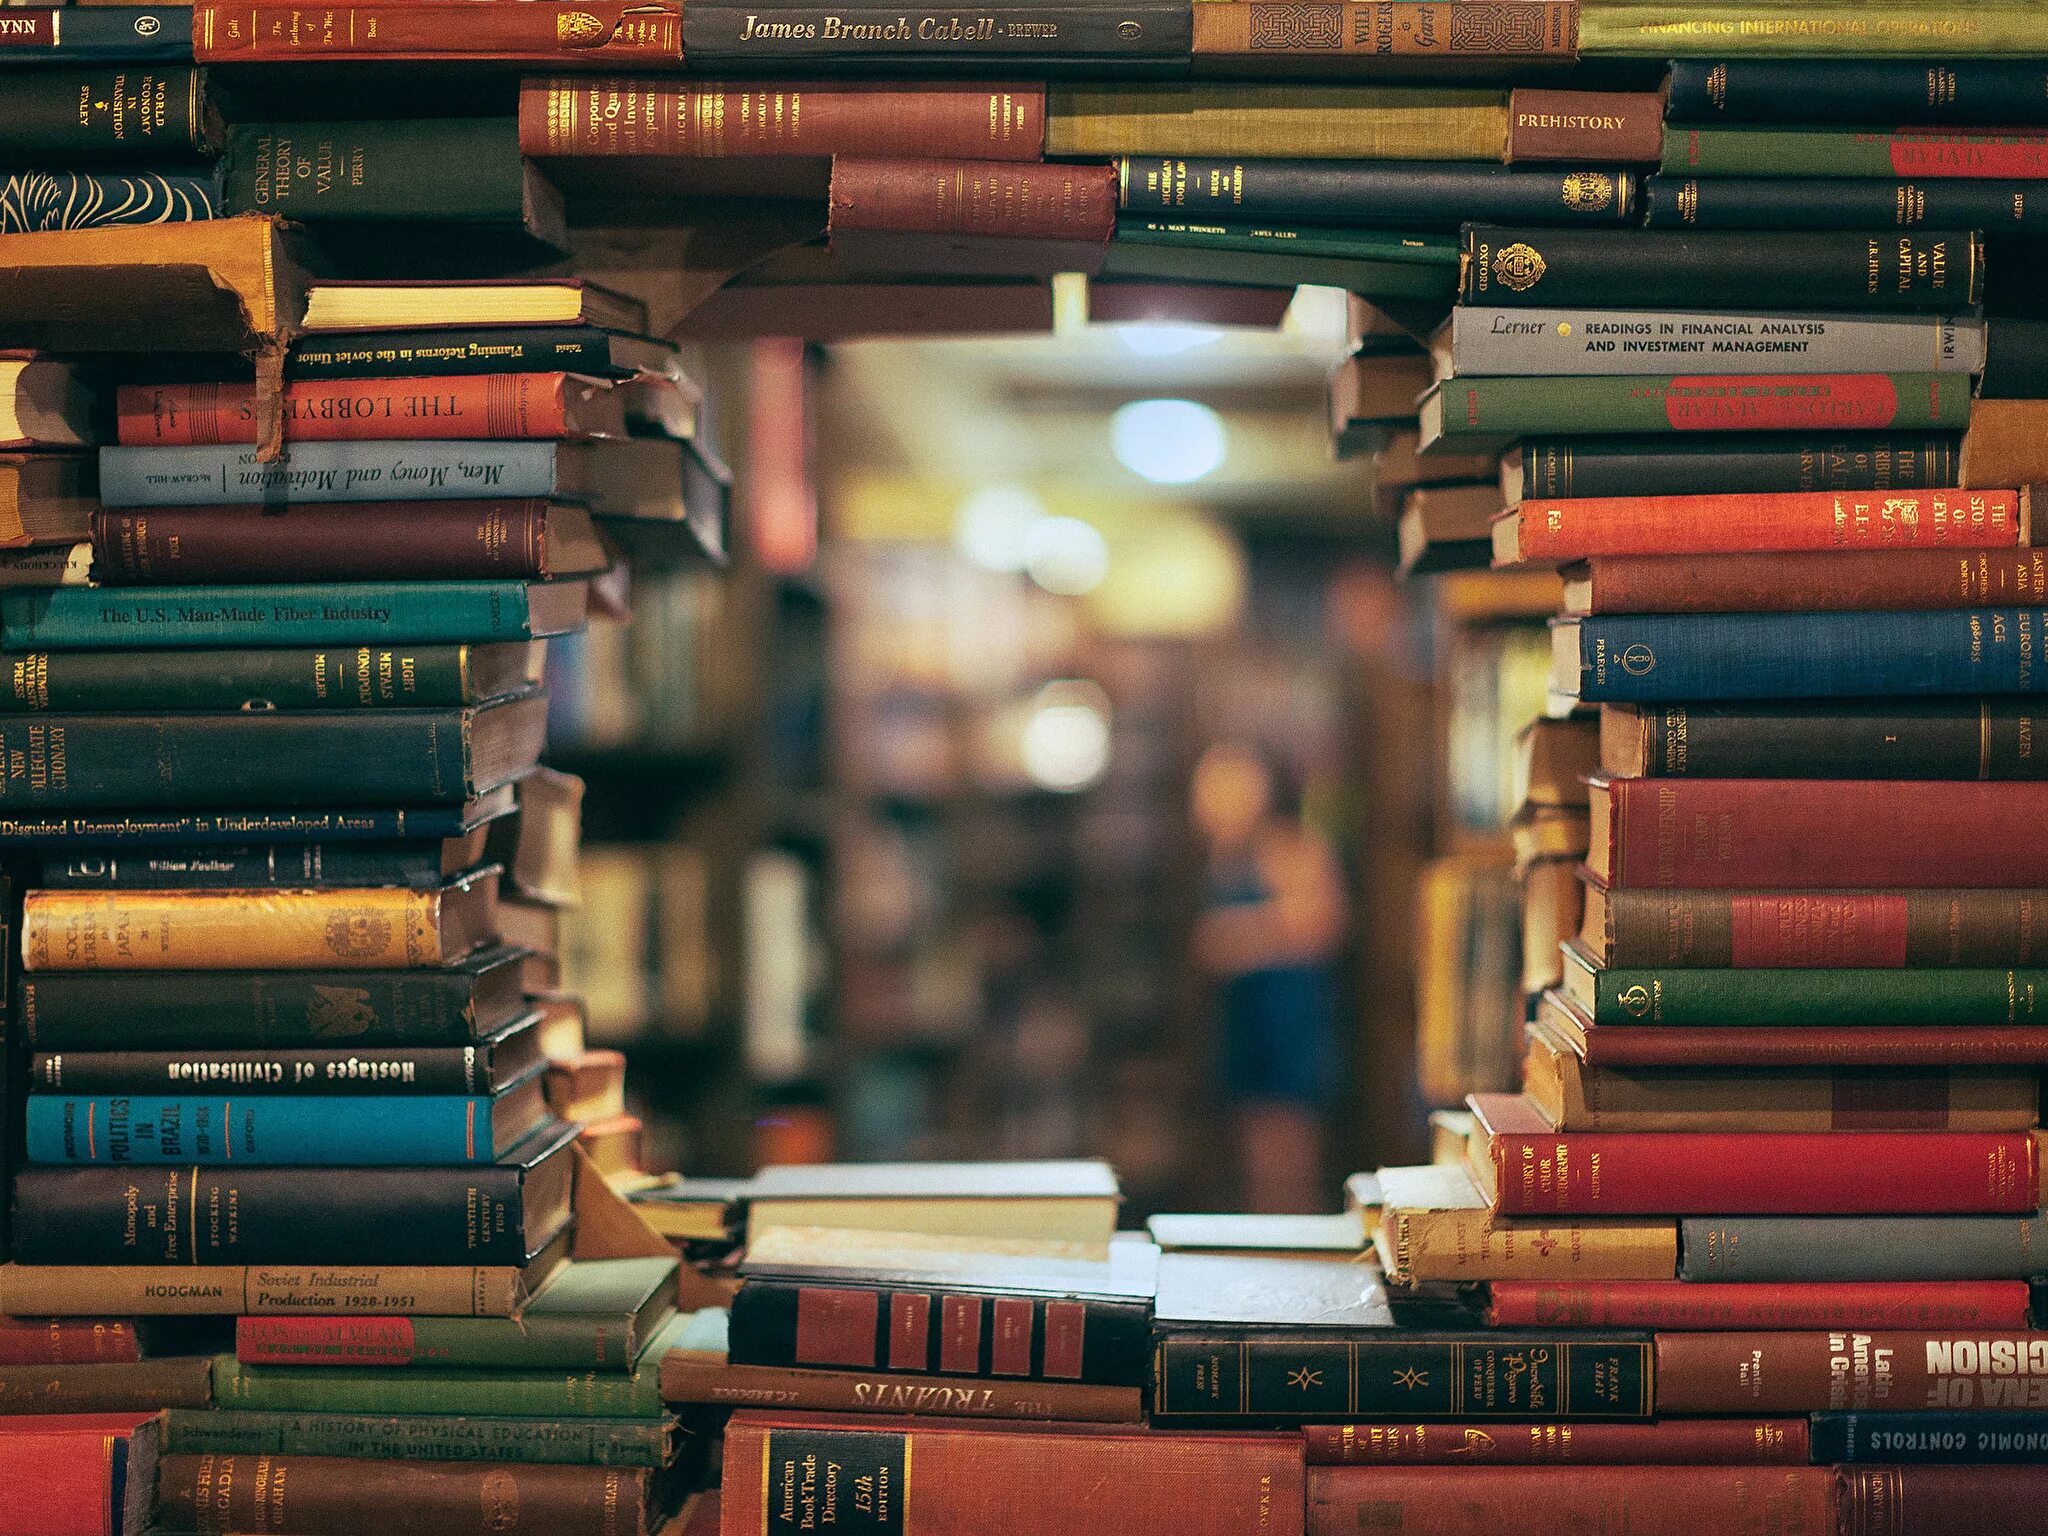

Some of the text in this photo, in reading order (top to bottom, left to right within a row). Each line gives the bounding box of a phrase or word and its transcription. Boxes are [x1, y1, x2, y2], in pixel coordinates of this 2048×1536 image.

[228, 17, 241, 39] Galt
[272, 20, 283, 36] The
[289, 11, 302, 48] Gathering
[307, 22, 317, 33] of
[324, 10, 334, 46] The West
[367, 17, 377, 39] Booth
[739, 15, 994, 41] James Branch Cabell
[1007, 23, 1057, 38] BREWER
[1355, 7, 1371, 44] WILL
[1639, 20, 1734, 35] FINANCING
[1740, 20, 1867, 36] INTERNATIONAL
[80, 85, 90, 127] STALEY
[114, 73, 125, 140] TRANSITION
[127, 97, 136, 110] IN
[141, 75, 153, 136] ECONOMY
[155, 81, 166, 127] WORLD
[587, 83, 601, 146] Corporate
[989, 95, 998, 140] PRINCETON
[1003, 93, 1011, 141] UNIVERSITY
[1016, 105, 1025, 131] PRESS
[1518, 113, 1626, 130] PREHISTORY
[256, 137, 272, 206] GENERAL
[275, 138, 293, 202] THEORY
[298, 157, 311, 180] OF
[316, 141, 333, 195] VALUE
[351, 145, 365, 187] PERRY
[1148, 171, 1157, 191] THE
[1162, 160, 1172, 206] MICHIGAN
[1176, 161, 1186, 206] POOR LAW
[1210, 169, 1220, 197] BRUCE
[1222, 176, 1230, 192] AND
[1896, 186, 1904, 224] LECTURES
[1906, 184, 1914, 226] CLASSICAL
[1916, 190, 1924, 220] SATHER
[1168, 224, 1186, 232] MAN
[1189, 225, 1226, 234] THINKETH
[1250, 229, 1297, 239] JAMES ALLEN
[1479, 243, 1489, 292] OXFORD
[1898, 238, 1911, 293] CAPITAL
[1917, 251, 1928, 277] AND
[1932, 241, 1945, 289] VALUE
[1491, 315, 1546, 337] Lerner
[1585, 323, 1825, 336] READINGS IN FINANCIAL ANALYSIS
[1943, 315, 1955, 360] IRWIN
[335, 351, 373, 363] Soviet
[376, 350, 396, 361] the
[400, 349, 412, 360] in
[416, 346, 466, 359] Reforms
[469, 343, 524, 357] Planning
[1585, 341, 1810, 353] AND INVESTMENT MANAGEMENT
[402, 395, 464, 417] THE
[145, 473, 211, 484] McGRAW-HILL
[238, 460, 505, 492] Men, Money and Motivation
[1900, 449, 1914, 479] THE
[1960, 559, 1969, 598] NORTON
[2017, 563, 2026, 591] ASIA
[2033, 551, 2044, 602] EASTERN
[101, 606, 392, 625] The U.S. Man-Made Fiber Industry
[1994, 613, 2005, 643] AGE
[1596, 637, 1606, 686] PRAEGER
[2019, 612, 2030, 692] EUROPEAN
[14, 661, 25, 699] PRESS
[314, 654, 325, 698] MULLER
[380, 651, 393, 700] METALS
[402, 657, 415, 693] LIGHT
[1676, 706, 1687, 773] HENRY HOLT
[2019, 716, 2031, 760] HAZEN
[10, 749, 25, 779] NEW
[195, 817, 209, 832] in
[215, 815, 330, 833] Underdeveloped
[335, 815, 375, 830] Areas
[168, 1056, 415, 1084] Hostages of Civilisation
[109, 1098, 130, 1162] POLITICS
[135, 1122, 154, 1139] IN
[161, 1103, 181, 1156] BRAZIL
[1522, 1144, 1535, 1160] OF
[1540, 1158, 1551, 1193] COLOR
[123, 1184, 139, 1246] Monopoly
[144, 1204, 157, 1228] and
[165, 1170, 179, 1260] Free Enterprise
[210, 1186, 220, 1247] STOCKING
[228, 1188, 239, 1244] WATKINS
[468, 1187, 477, 1249] TWENTIETH
[482, 1193, 491, 1243] CENTURY
[495, 1203, 505, 1233] FUND
[1456, 1221, 1467, 1266] AGAINST
[144, 1285, 223, 1298] HODGMAN
[257, 1272, 380, 1288] Soviet Industrial
[257, 1291, 416, 1308] Production 1928-1951
[1739, 1362, 1749, 1387] Hall
[1751, 1349, 1762, 1398] Prentice
[1829, 1333, 1850, 1409] in Crisis
[1874, 1348, 1894, 1398] Latin
[1925, 1340, 2048, 1374] CISION
[1197, 1364, 1205, 1393] PRESS
[1210, 1353, 1220, 1400] MOHAWK
[1474, 1358, 1483, 1402] OF PERU
[1485, 1349, 1496, 1410] CONQUEROR
[1595, 1360, 1604, 1399] SHAY
[1609, 1356, 1619, 1403] FRANK
[1926, 1377, 1972, 1408] OF
[854, 1381, 995, 1412] TRUANTS
[408, 1425, 484, 1439] PHYSICAL
[1870, 1430, 2048, 1450] CONTROLS ONOMIC
[407, 1443, 464, 1457] UNITED
[470, 1445, 524, 1459] STATES
[272, 1466, 287, 1525] GRAHAM
[779, 1459, 795, 1524] American
[800, 1452, 816, 1530] Book Trade
[821, 1460, 842, 1525] Directory
[855, 1475, 874, 1513] 15th
[878, 1465, 889, 1522] EDITION
[1872, 1472, 1885, 1509] HENRY
